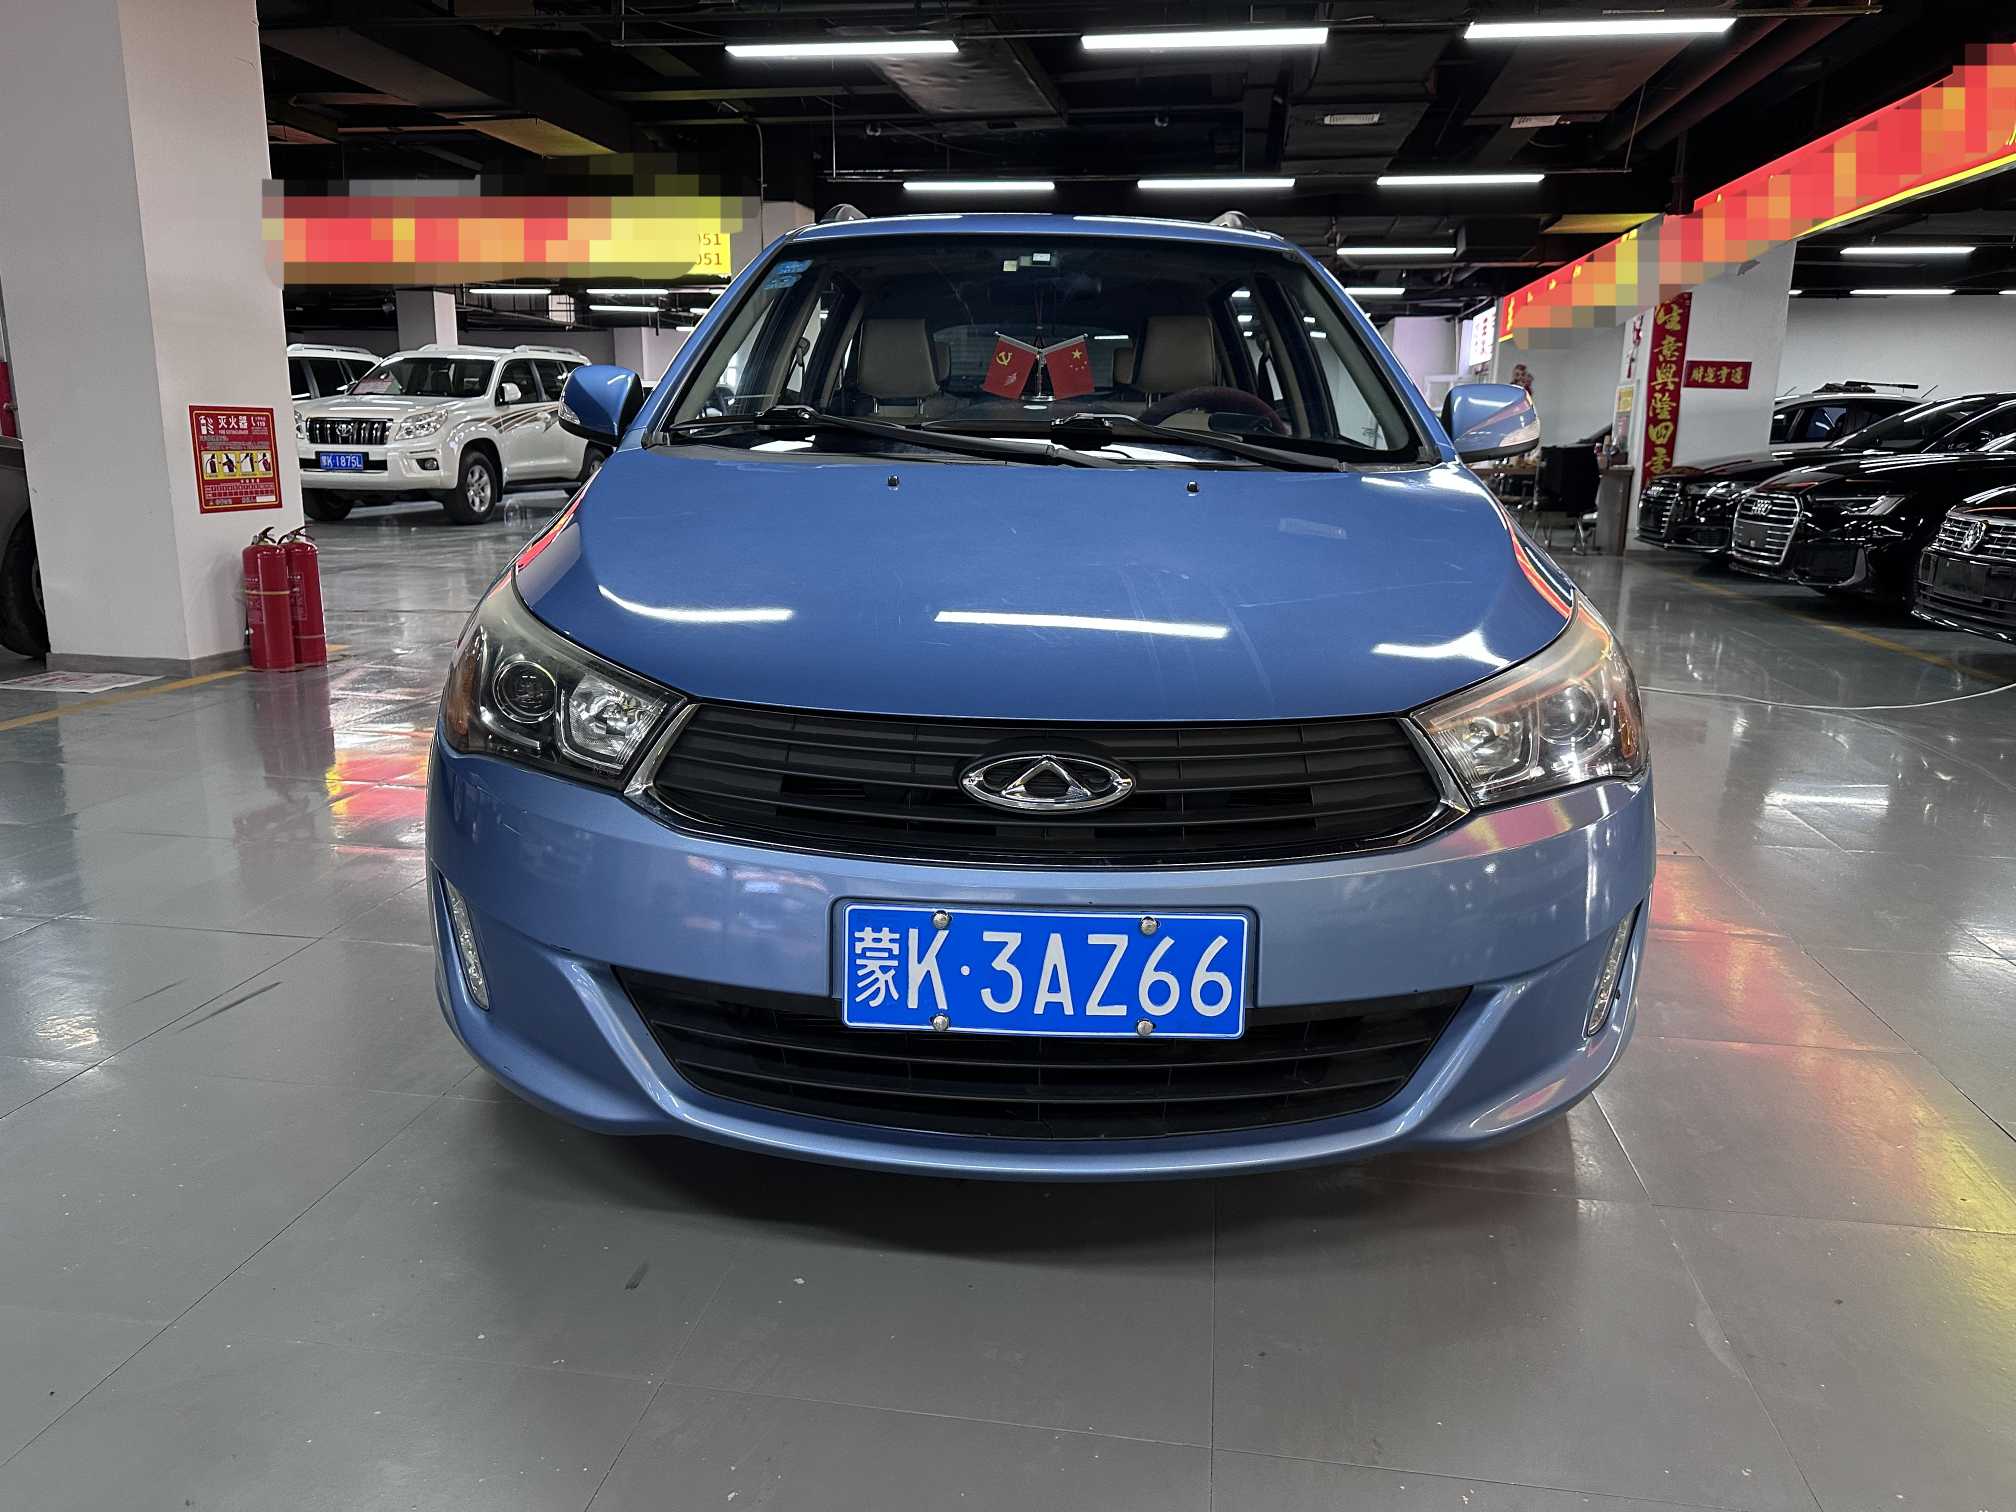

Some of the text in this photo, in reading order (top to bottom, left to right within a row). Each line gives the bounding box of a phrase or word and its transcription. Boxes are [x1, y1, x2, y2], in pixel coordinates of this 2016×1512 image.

[217, 415, 248, 429] 灭火器
[854, 926, 1233, 1018] 蒙K·3AZ66
